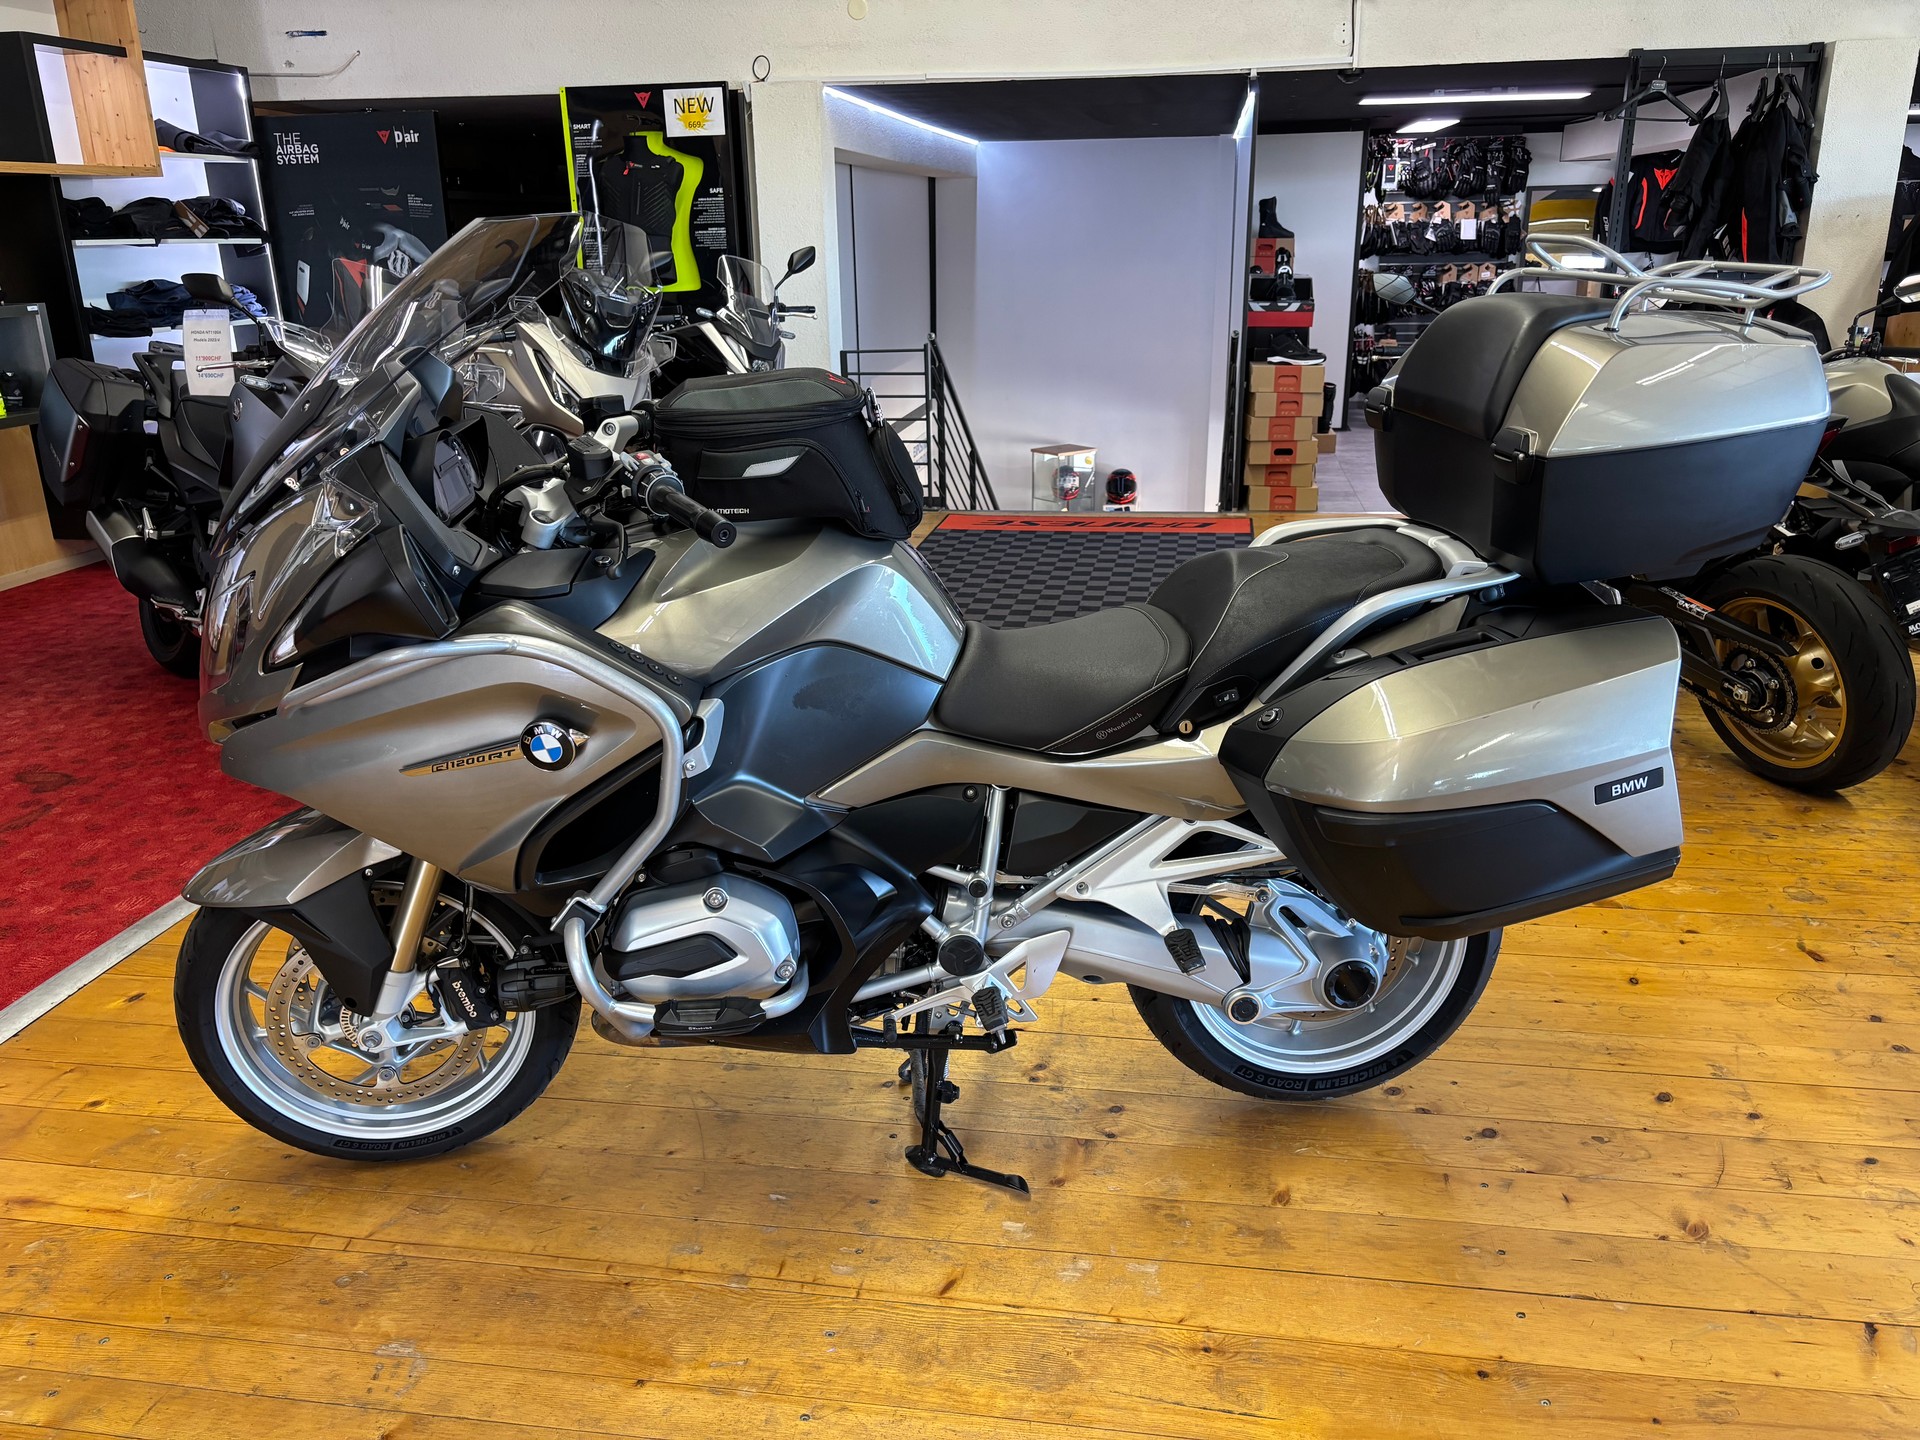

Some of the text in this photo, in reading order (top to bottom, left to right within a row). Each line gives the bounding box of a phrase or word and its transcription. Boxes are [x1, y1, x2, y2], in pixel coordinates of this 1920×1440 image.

[673, 96, 715, 115] NEW
[273, 132, 302, 145] THE
[276, 143, 319, 155] AIRBAG
[277, 154, 320, 165] SYSTEM
[973, 519, 1216, 529] DAINESE
[1105, 712, 1143, 735] Wunderlich
[523, 726, 563, 745] BMW
[1611, 776, 1649, 797] BMW
[451, 980, 478, 1019] brembo
[1236, 1067, 1304, 1090] ROAD 6 GT
[1315, 1062, 1387, 1090] MICHELIN
[337, 1140, 352, 1148] GT
[361, 1142, 389, 1150] ROAD
[398, 1132, 447, 1149] MICHELIN
